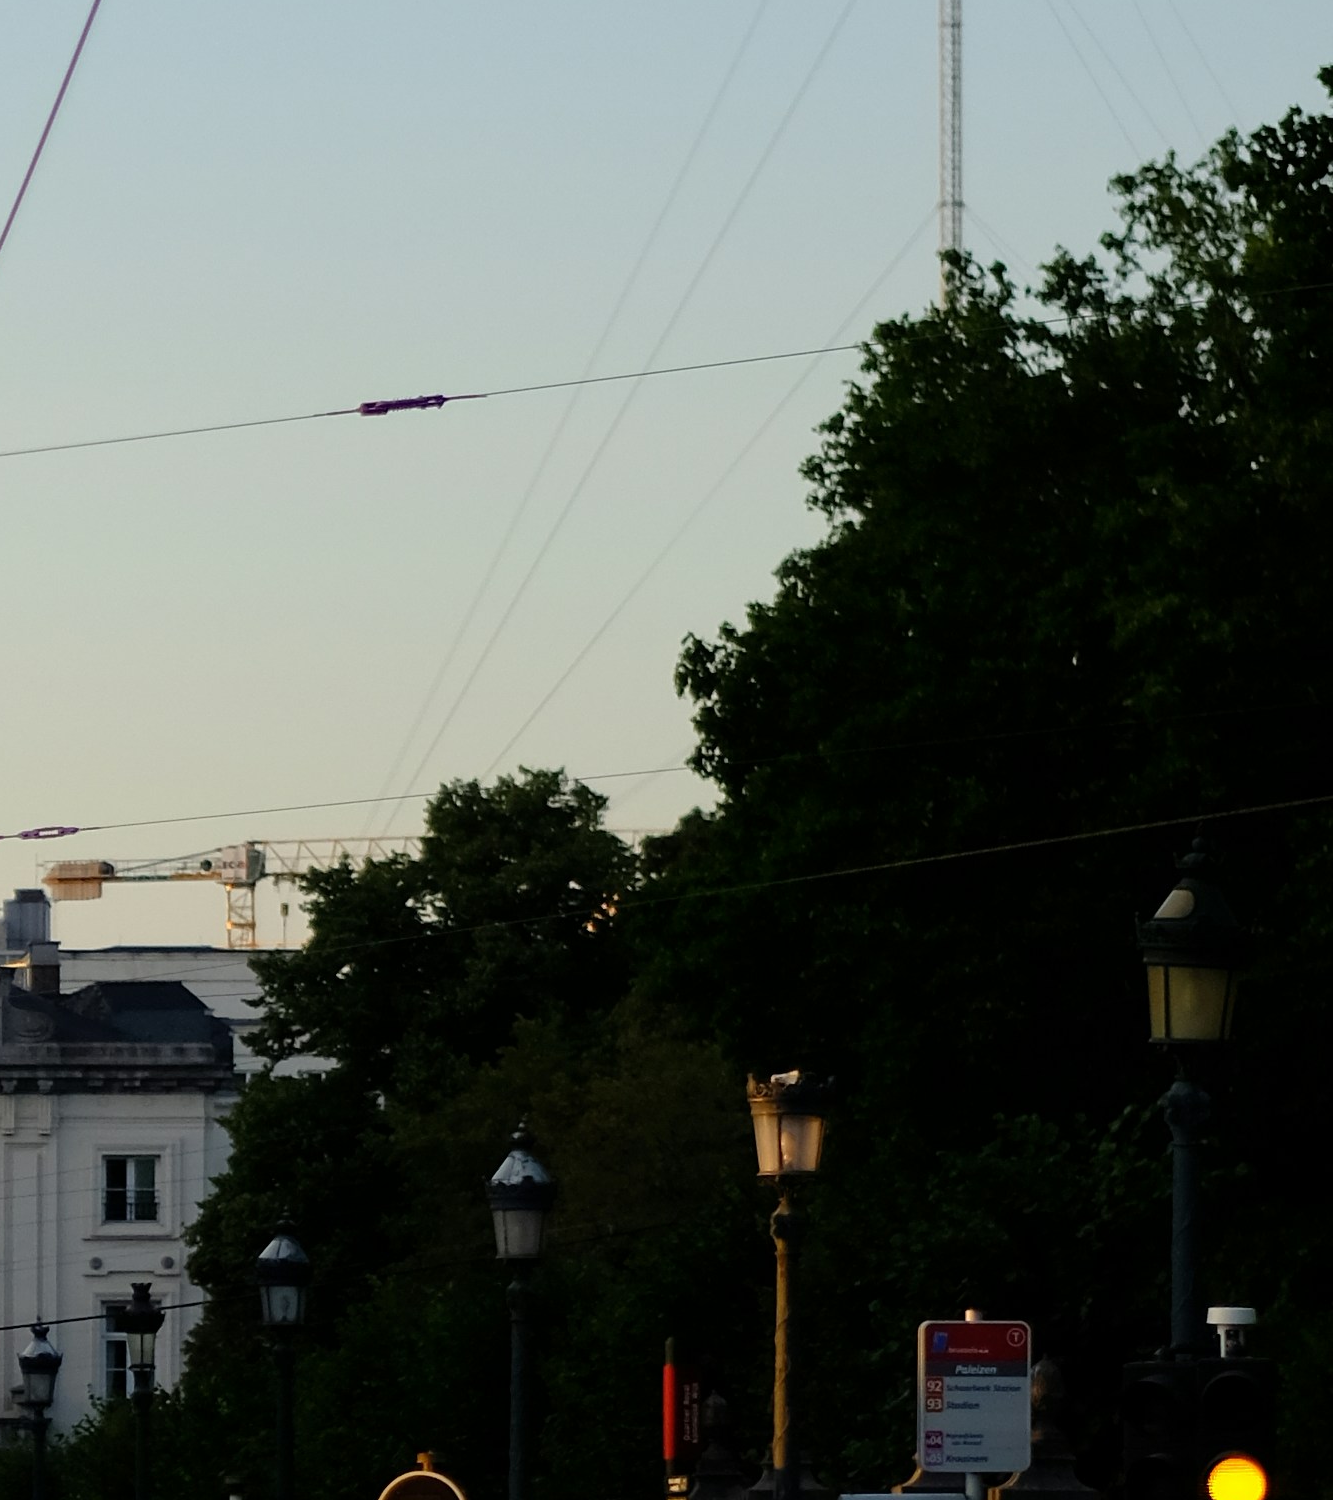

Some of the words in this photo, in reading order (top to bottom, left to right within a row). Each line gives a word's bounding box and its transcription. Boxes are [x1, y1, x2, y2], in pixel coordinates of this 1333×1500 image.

[955, 1364, 997, 1375] Paleizen
[926, 1379, 943, 1392] 92
[926, 1398, 943, 1410] 93
